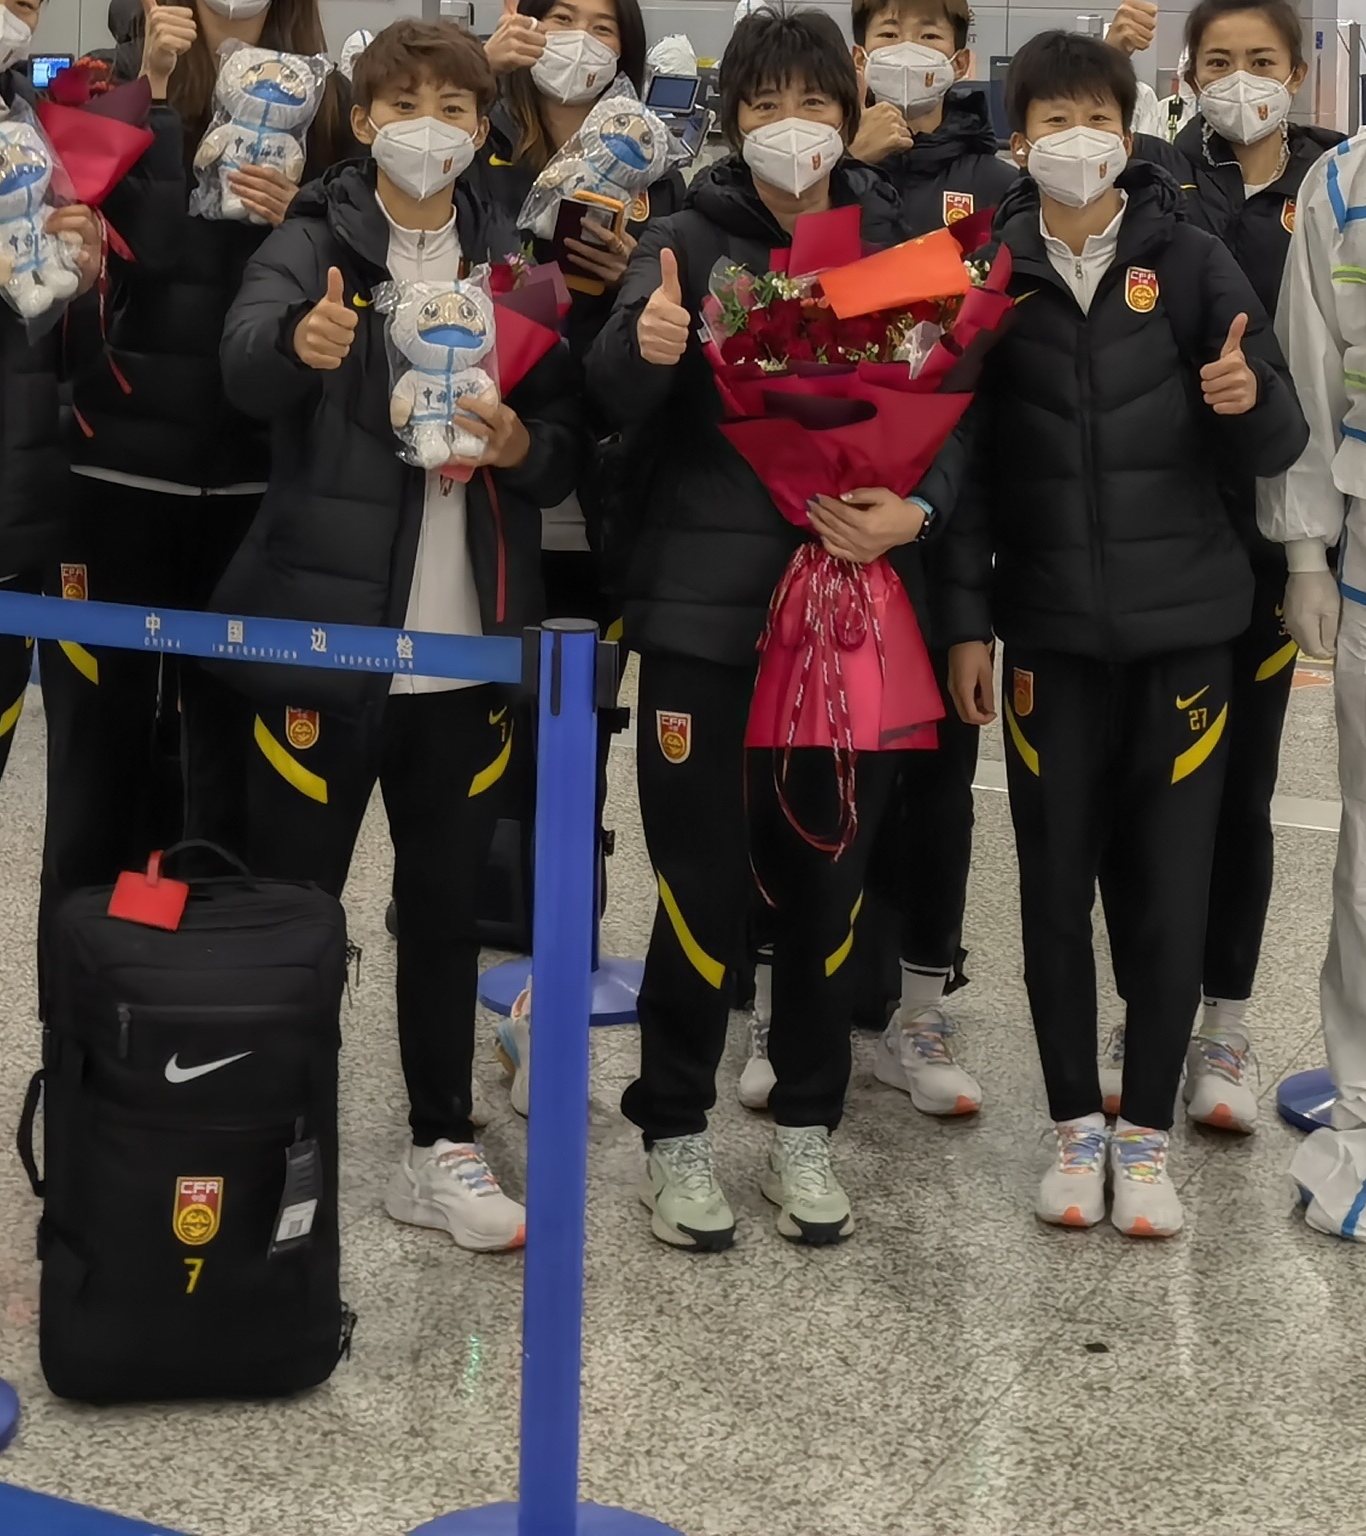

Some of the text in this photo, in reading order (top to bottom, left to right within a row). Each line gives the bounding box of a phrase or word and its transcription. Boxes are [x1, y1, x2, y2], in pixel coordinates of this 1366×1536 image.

[145, 612, 414, 659] 中国边检
[661, 716, 686, 727] CFA
[1188, 707, 1207, 731] 27
[180, 1181, 219, 1194] CFA
[183, 1257, 205, 1294] 7
